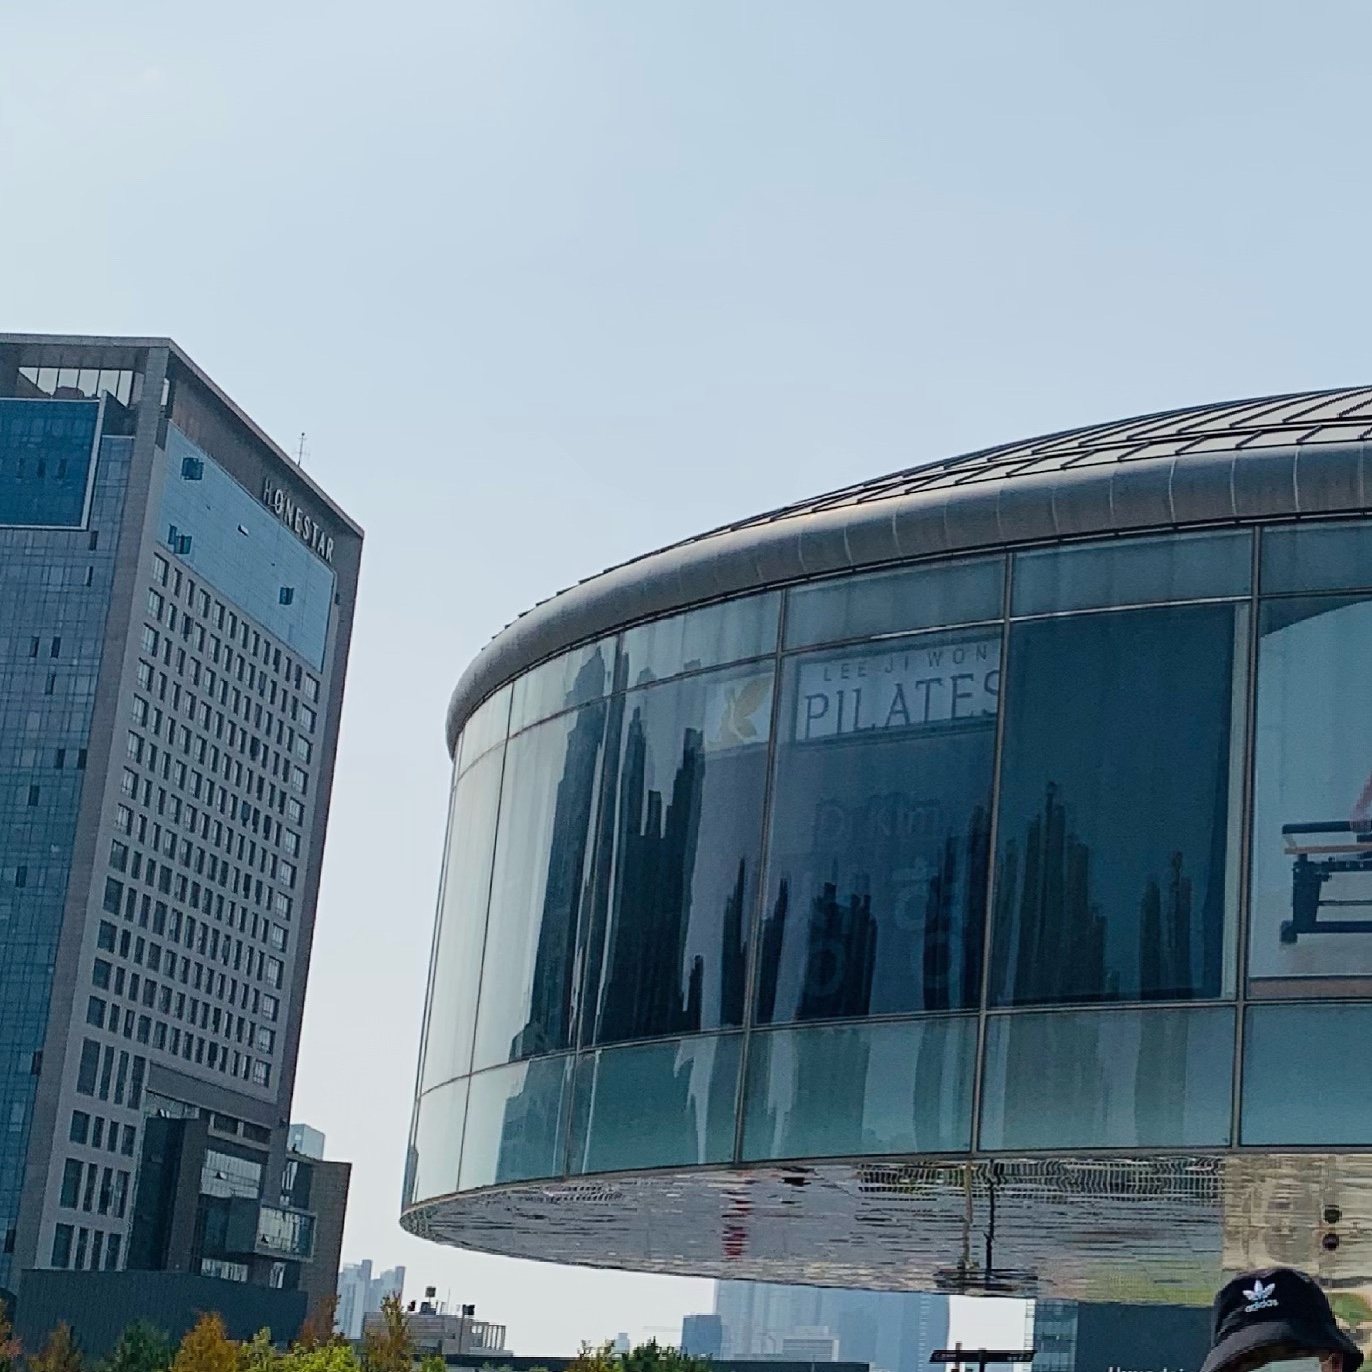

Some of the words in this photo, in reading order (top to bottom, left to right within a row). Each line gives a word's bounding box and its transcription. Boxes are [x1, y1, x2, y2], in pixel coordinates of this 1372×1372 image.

[263, 479, 334, 562] HONESTAR
[823, 662, 867, 682] LEE
[884, 656, 909, 674] JI
[928, 645, 987, 668] WON
[804, 669, 1000, 740] PILATES
[1244, 1298, 1279, 1312] adidas
